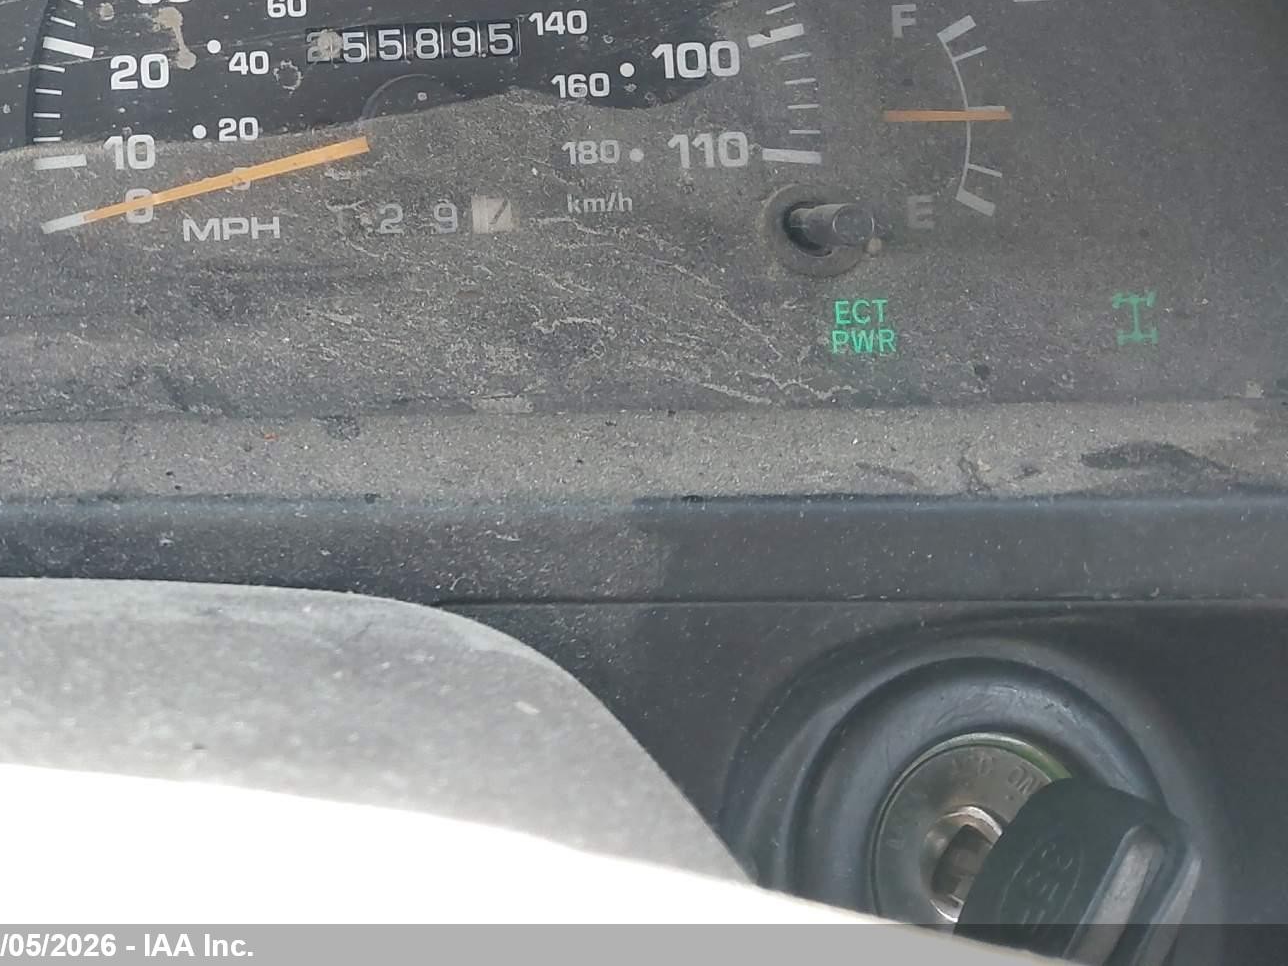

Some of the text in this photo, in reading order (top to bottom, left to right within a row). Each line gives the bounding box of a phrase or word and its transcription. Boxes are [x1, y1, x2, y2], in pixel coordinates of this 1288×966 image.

[528, 9, 588, 35] 140
[891, 3, 917, 38] F
[110, 53, 170, 90] 20
[228, 50, 269, 75] 40
[651, 40, 740, 79] 100
[551, 72, 610, 98] 160
[218, 117, 259, 142] 20
[103, 133, 156, 170] 10
[561, 139, 621, 165] 180
[667, 131, 749, 169] 110
[125, 188, 154, 224] 0
[566, 192, 634, 214] km/h
[907, 194, 935, 229] E
[182, 216, 280, 242] MPH
[833, 299, 888, 325] ECT
[831, 329, 897, 354] PWR
